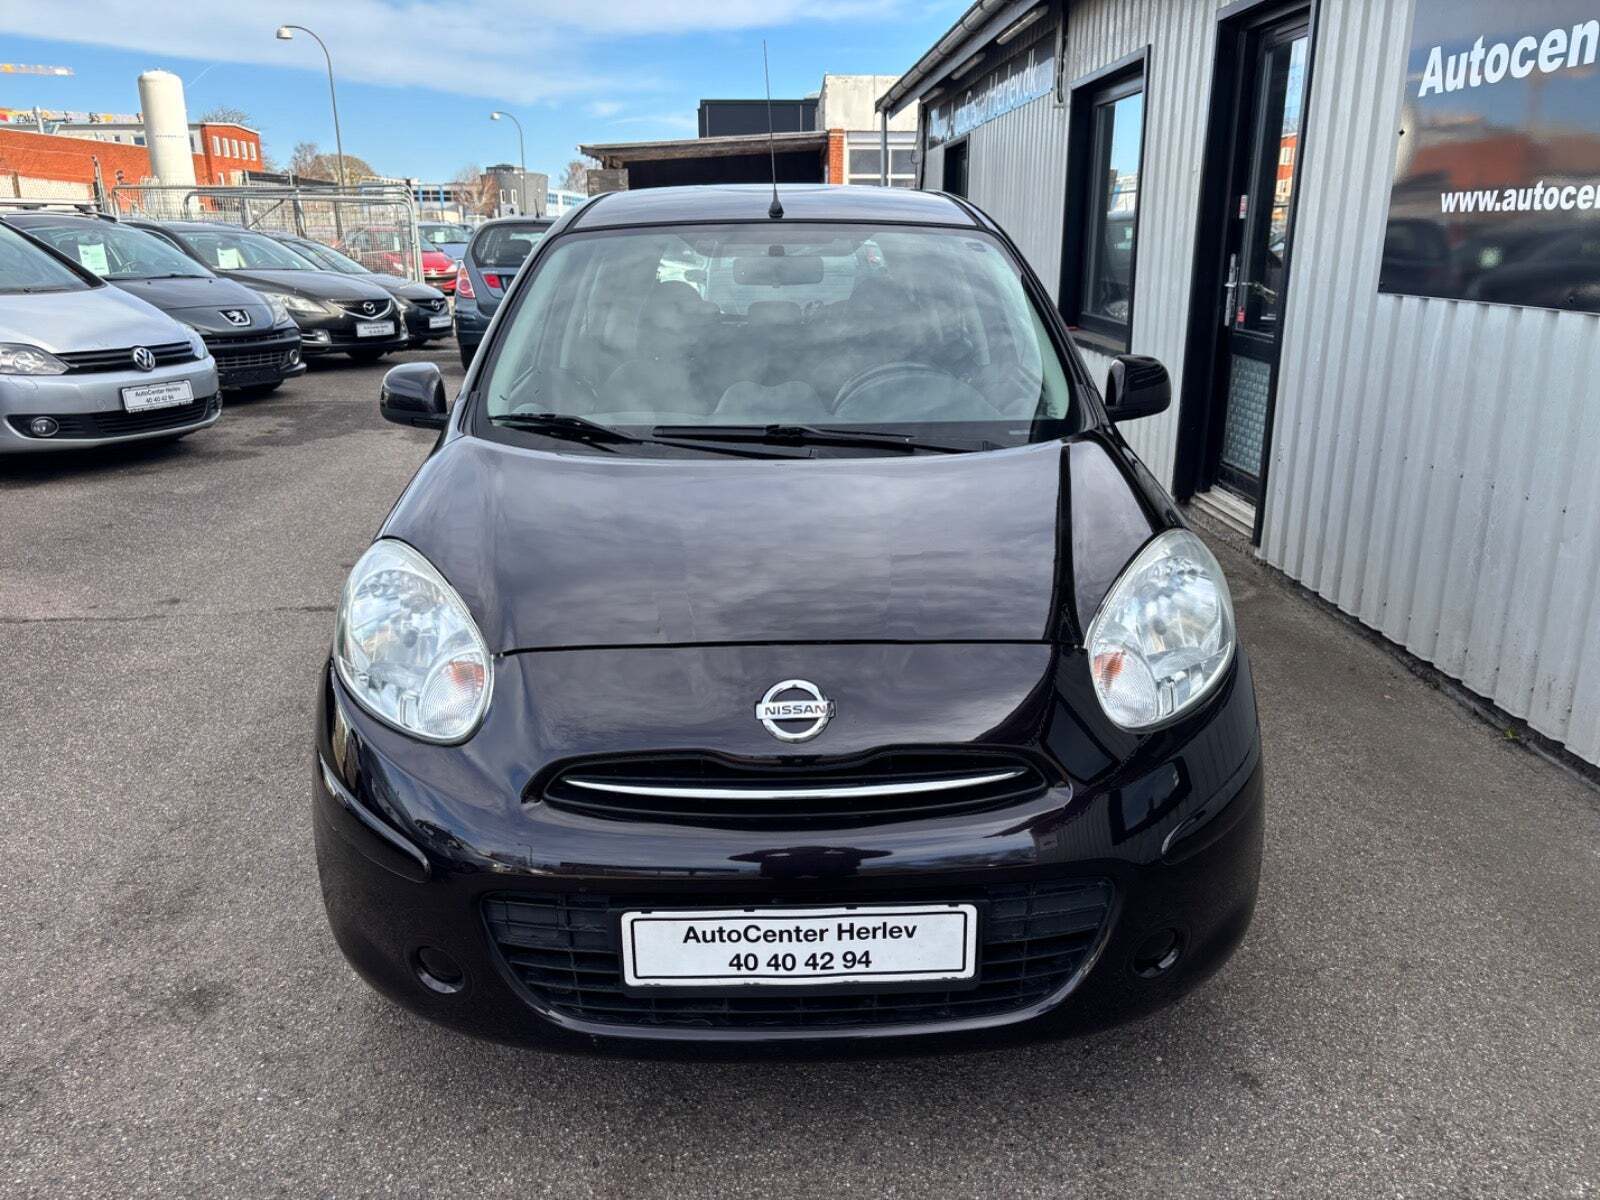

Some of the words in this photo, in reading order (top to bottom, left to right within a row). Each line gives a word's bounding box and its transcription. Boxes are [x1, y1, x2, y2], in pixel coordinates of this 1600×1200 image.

[1417, 19, 1600, 98] Autocen
[764, 704, 826, 716] NISSAN
[682, 924, 829, 944] AutoCenter
[836, 921, 917, 941] Herlev
[728, 953, 759, 972] 40
[766, 953, 797, 971] 40
[804, 952, 834, 971] 42
[841, 950, 872, 969] 94
